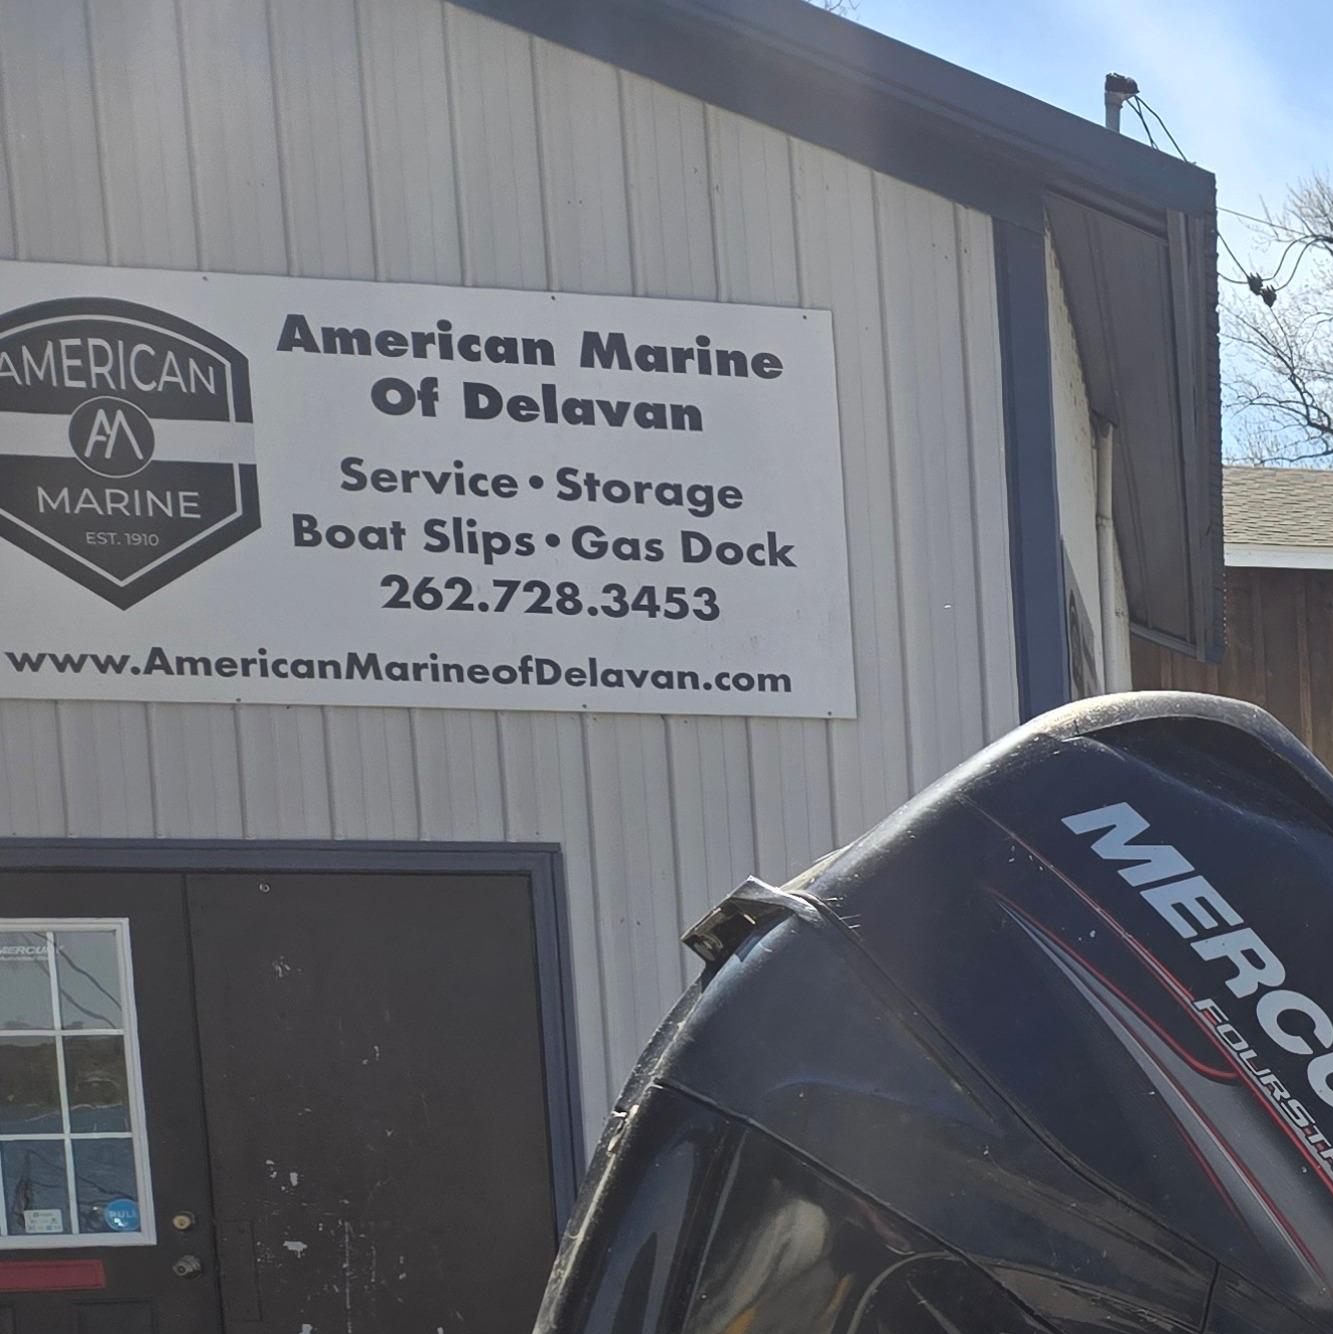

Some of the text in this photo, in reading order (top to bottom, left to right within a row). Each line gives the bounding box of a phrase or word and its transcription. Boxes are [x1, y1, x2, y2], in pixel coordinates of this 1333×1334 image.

[0, 337, 216, 394] AMERICAN
[276, 313, 784, 381] American Marine
[370, 376, 704, 433] Of Delavan
[36, 486, 201, 518] MARINE
[340, 456, 744, 519] Service Storage
[86, 531, 160, 547] EST. 1910
[292, 512, 797, 569] Boat Slips Gas Dock
[380, 573, 722, 623] 262.728.3453
[4, 646, 793, 694] www.AmericanMarineofDelavan.com
